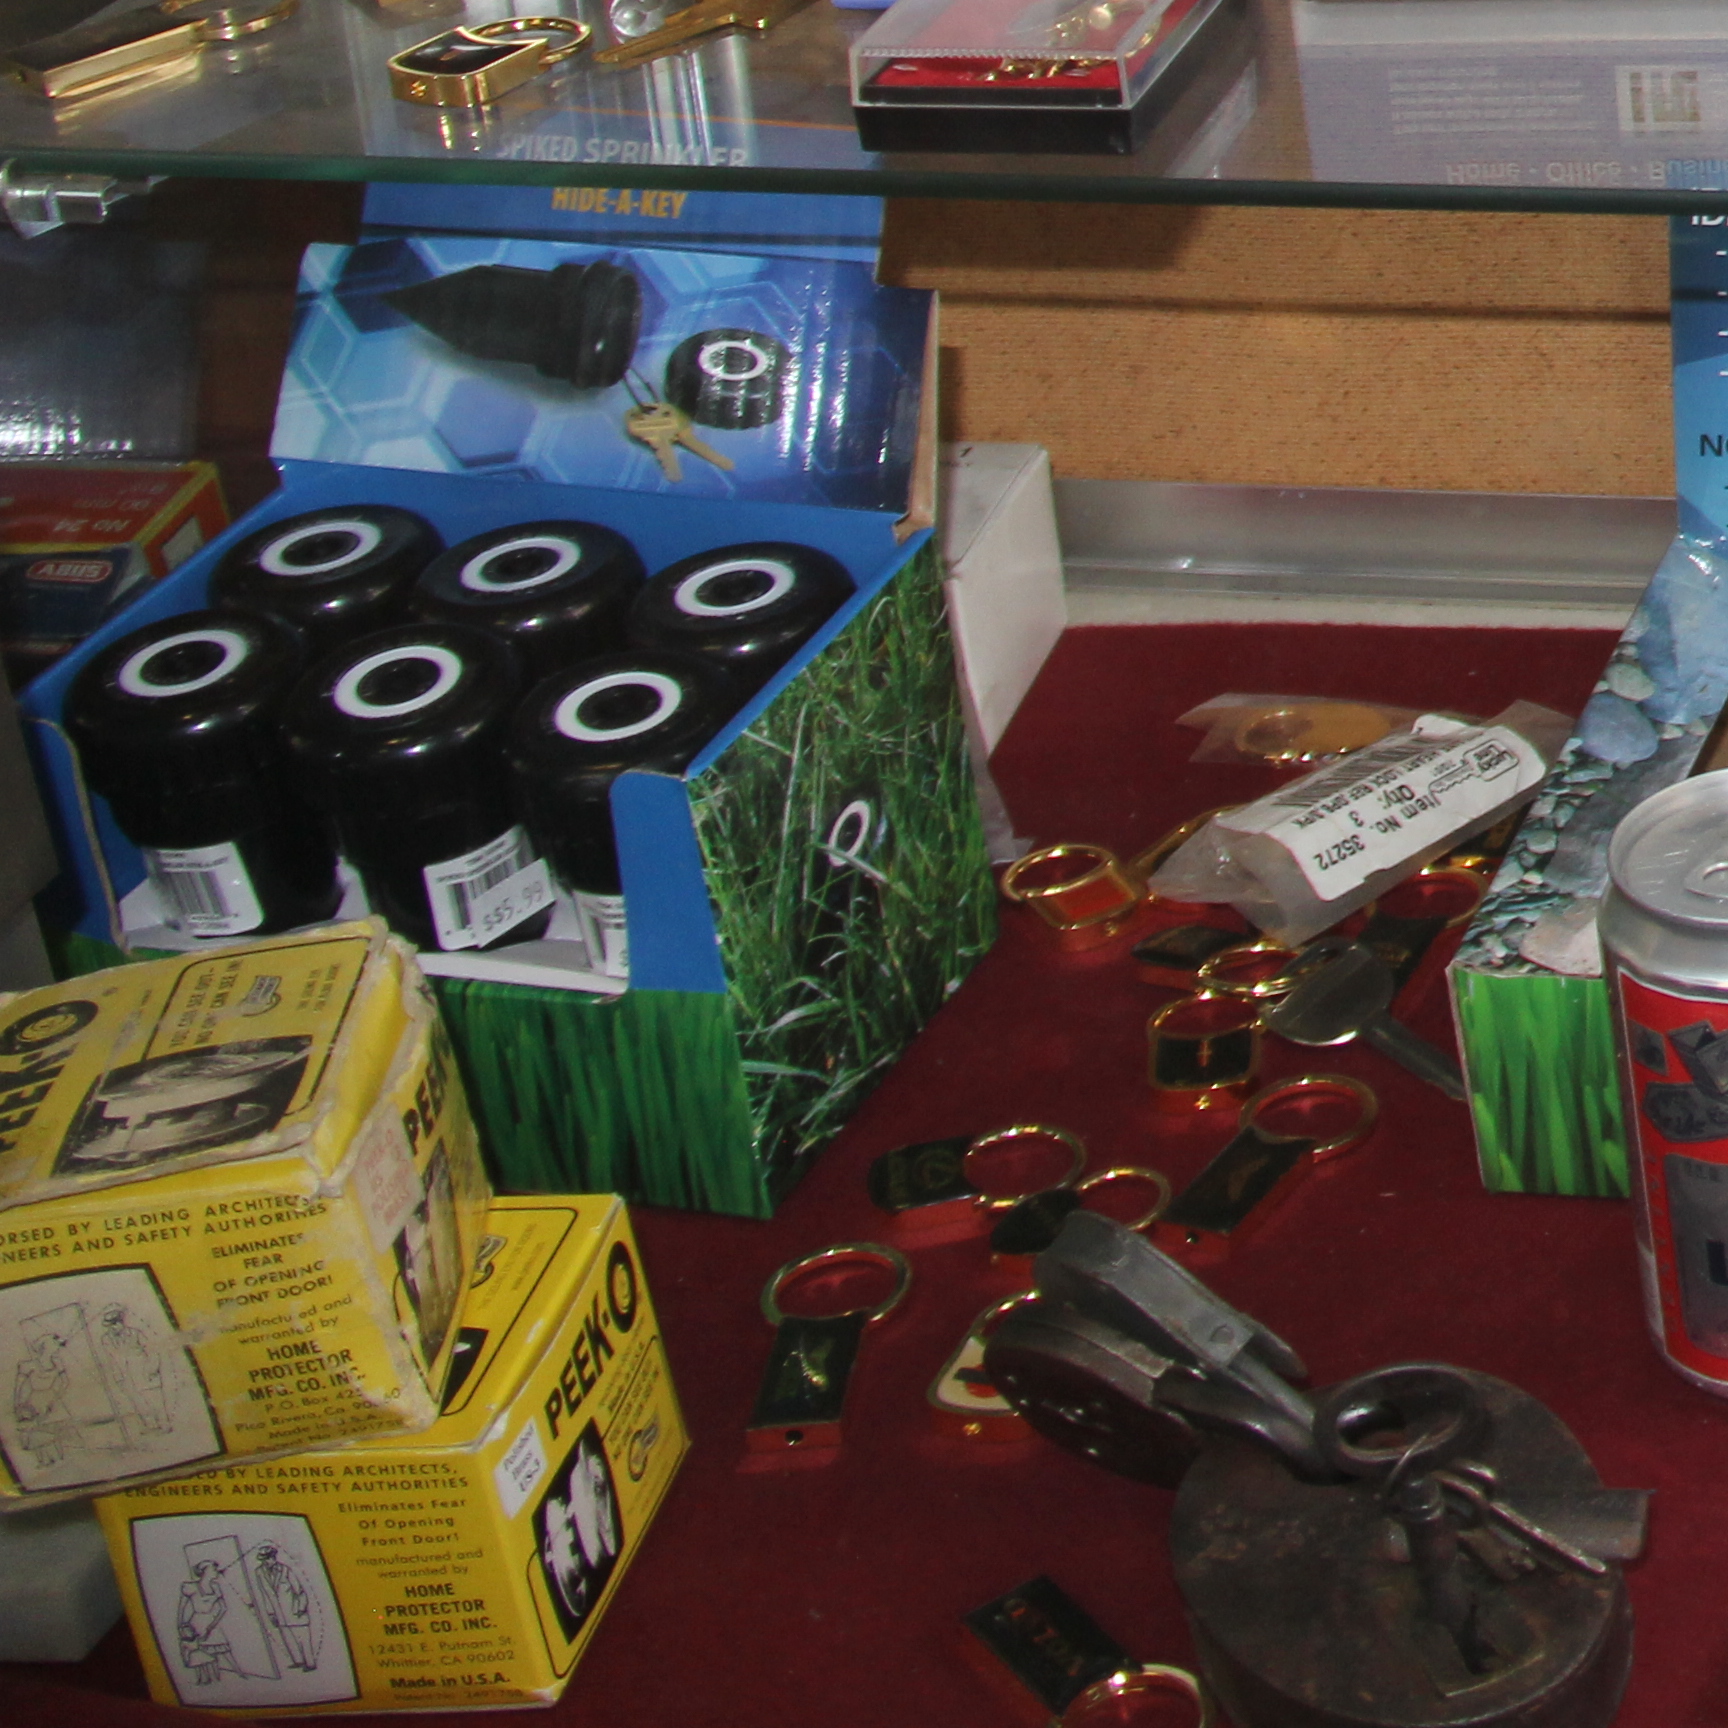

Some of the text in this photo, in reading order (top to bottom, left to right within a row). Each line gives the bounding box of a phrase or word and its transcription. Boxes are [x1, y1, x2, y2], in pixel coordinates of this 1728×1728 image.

[551, 187, 688, 218] HIDE-A-KEY
[1348, 784, 1417, 828] Qty: 3
[1313, 795, 1441, 871] Item No. 35272
[69, 1209, 191, 1236] BY LEADING
[243, 1253, 284, 1269] FEAR
[268, 1340, 322, 1361] HOME
[226, 1467, 248, 1480] BY
[256, 1465, 336, 1479] LEADING
[232, 1482, 268, 1495] AND
[275, 1480, 342, 1495] SAFETY
[351, 1477, 469, 1493] AUTHORITIES
[338, 1497, 467, 1513] Eliminates Fear
[405, 1583, 455, 1598] HOME
[385, 1599, 486, 1618] PROTECTOR
[383, 1616, 497, 1636] MFG. CO. INC.
[390, 1672, 512, 1690] Made in U.S.A.
